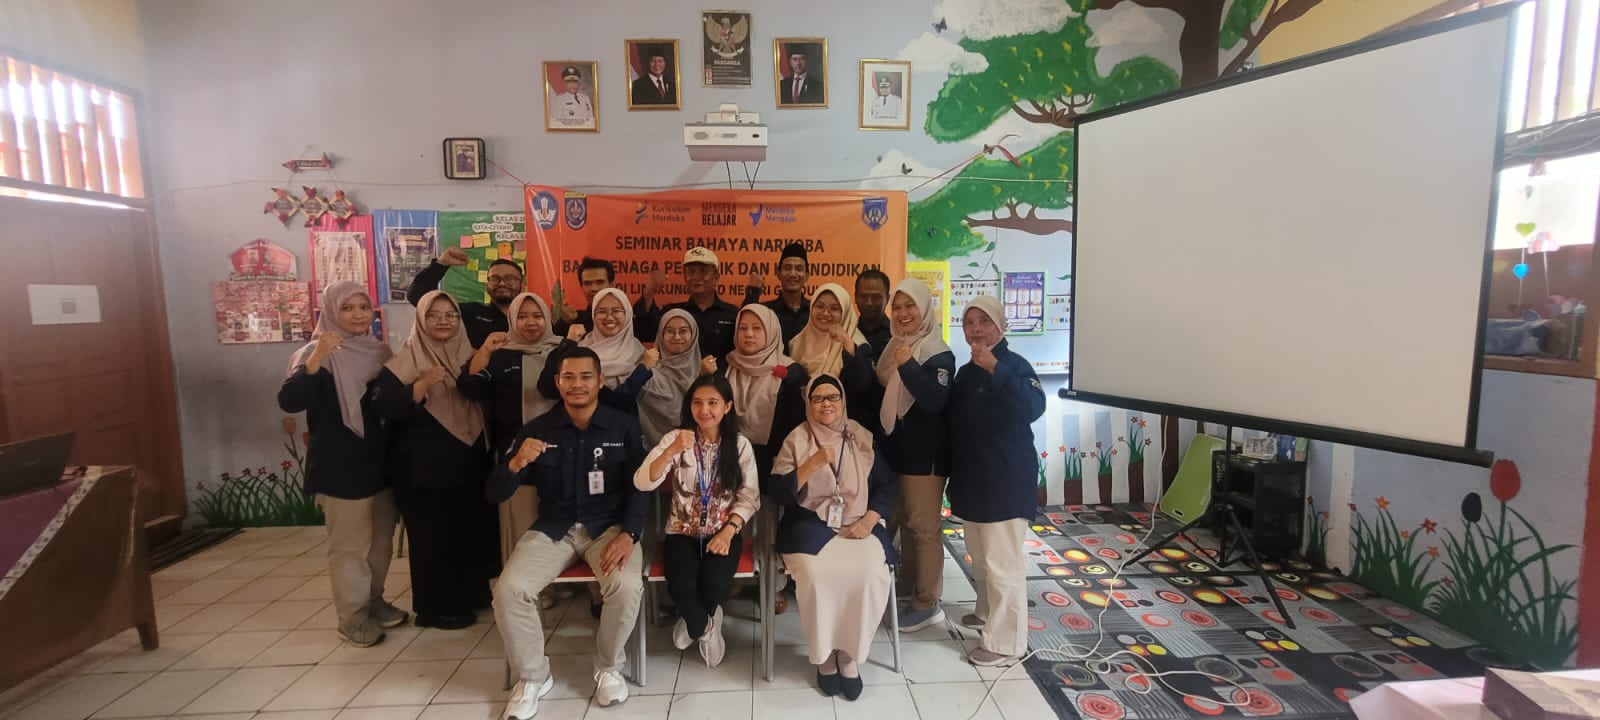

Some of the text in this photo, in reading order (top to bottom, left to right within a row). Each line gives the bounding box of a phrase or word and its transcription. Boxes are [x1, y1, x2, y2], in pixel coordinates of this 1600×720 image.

[702, 214, 736, 226] BELAJAR
[615, 236, 682, 251] SEMINAR
[686, 237, 749, 252] BAHAYA
[738, 262, 770, 276] DAN
